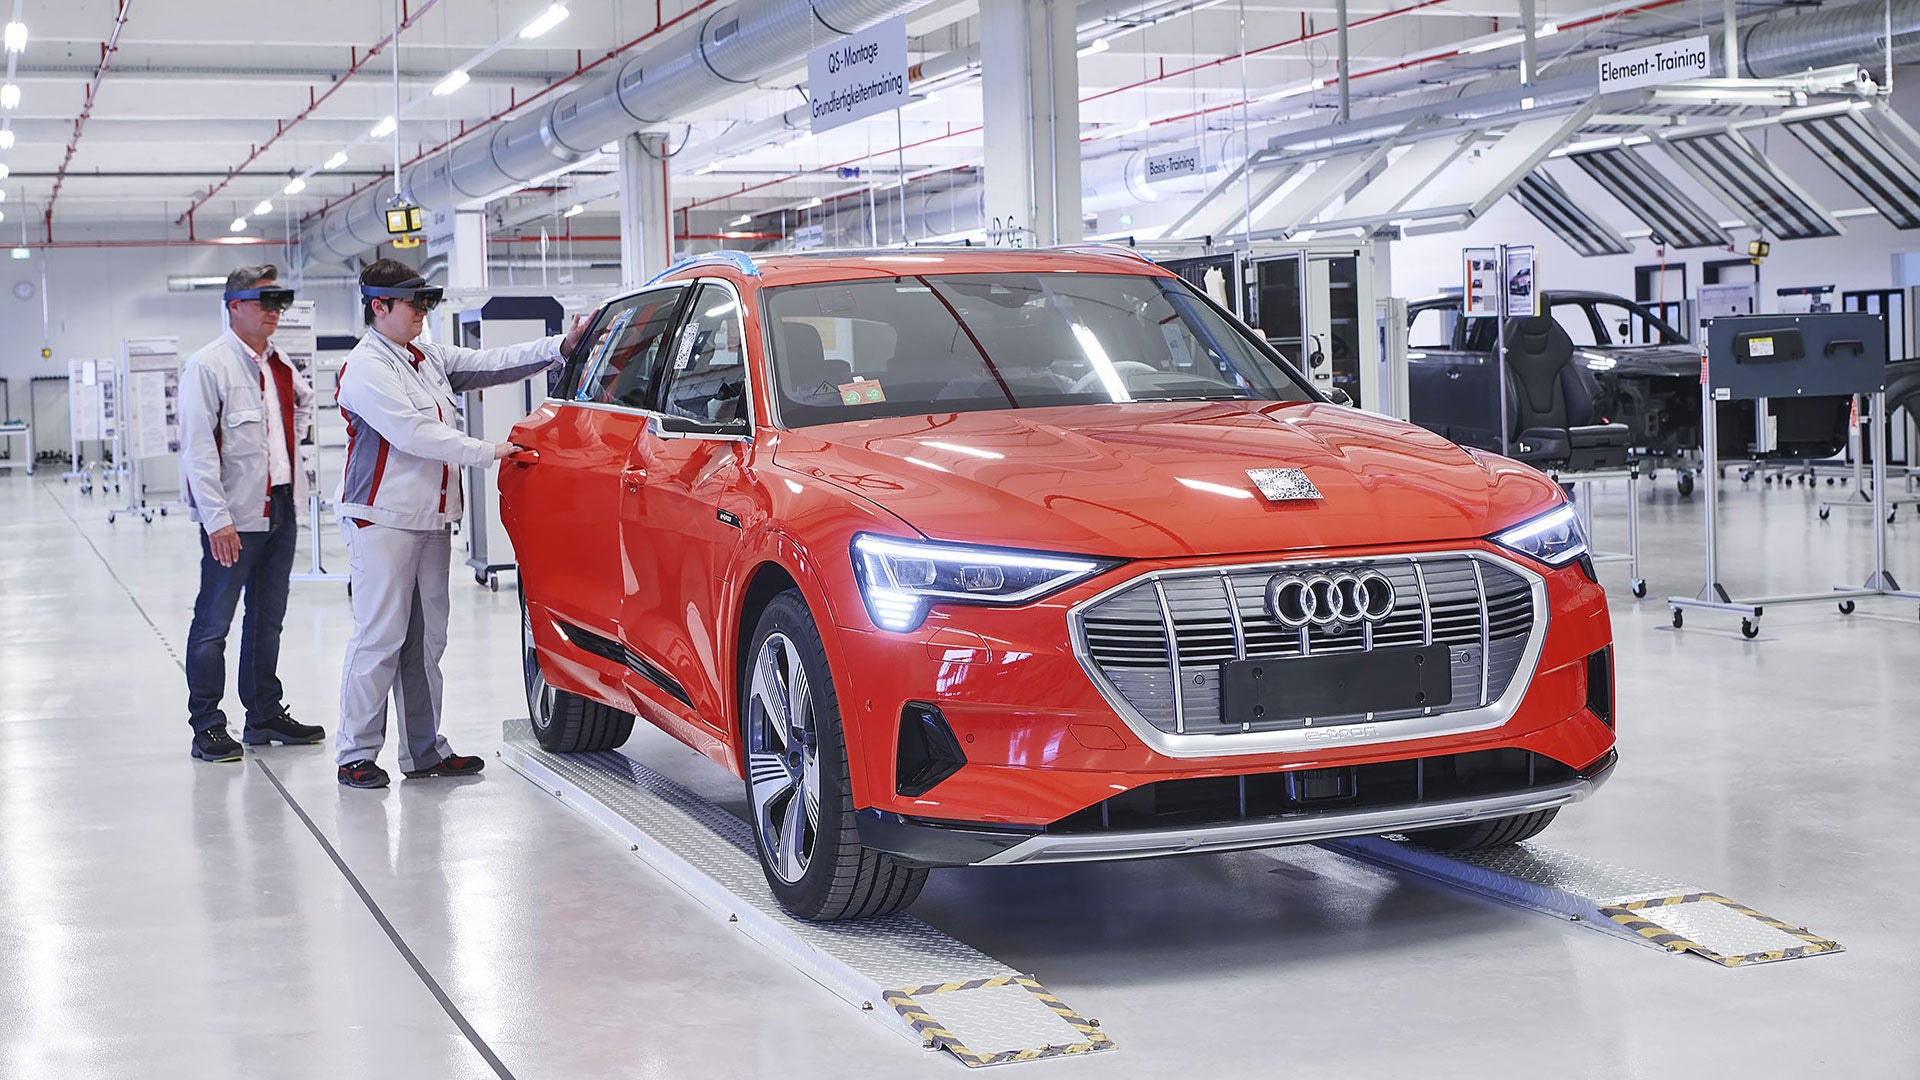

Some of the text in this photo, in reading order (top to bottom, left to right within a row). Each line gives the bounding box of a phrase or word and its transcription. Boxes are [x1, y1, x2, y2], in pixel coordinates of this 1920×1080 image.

[828, 42, 878, 74] QS-Montage
[1601, 48, 1706, 81] Element-Training
[812, 72, 903, 118] Grundfertigkeitentraining
[1305, 726, 1379, 742] e-tron
